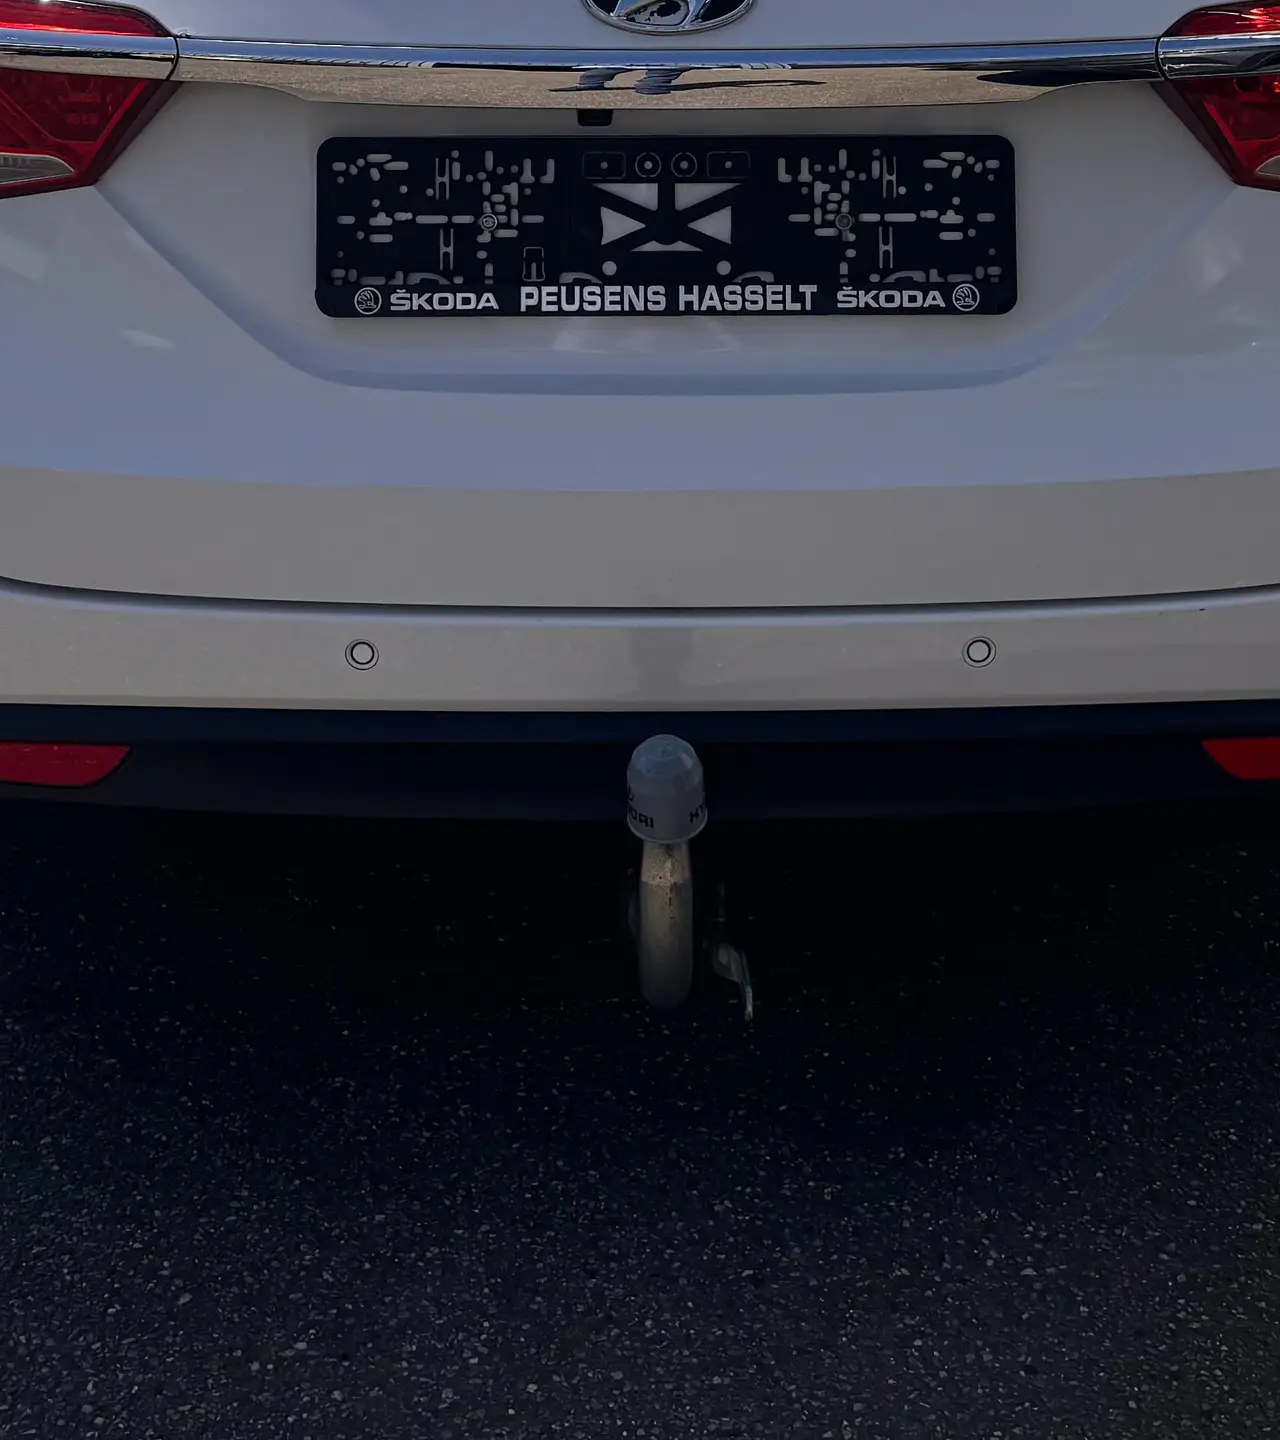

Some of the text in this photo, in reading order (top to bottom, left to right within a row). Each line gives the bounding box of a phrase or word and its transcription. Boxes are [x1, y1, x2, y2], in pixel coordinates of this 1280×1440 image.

[389, 284, 947, 312] ŠKODA PEUSENS HASSELT ŠKODA
